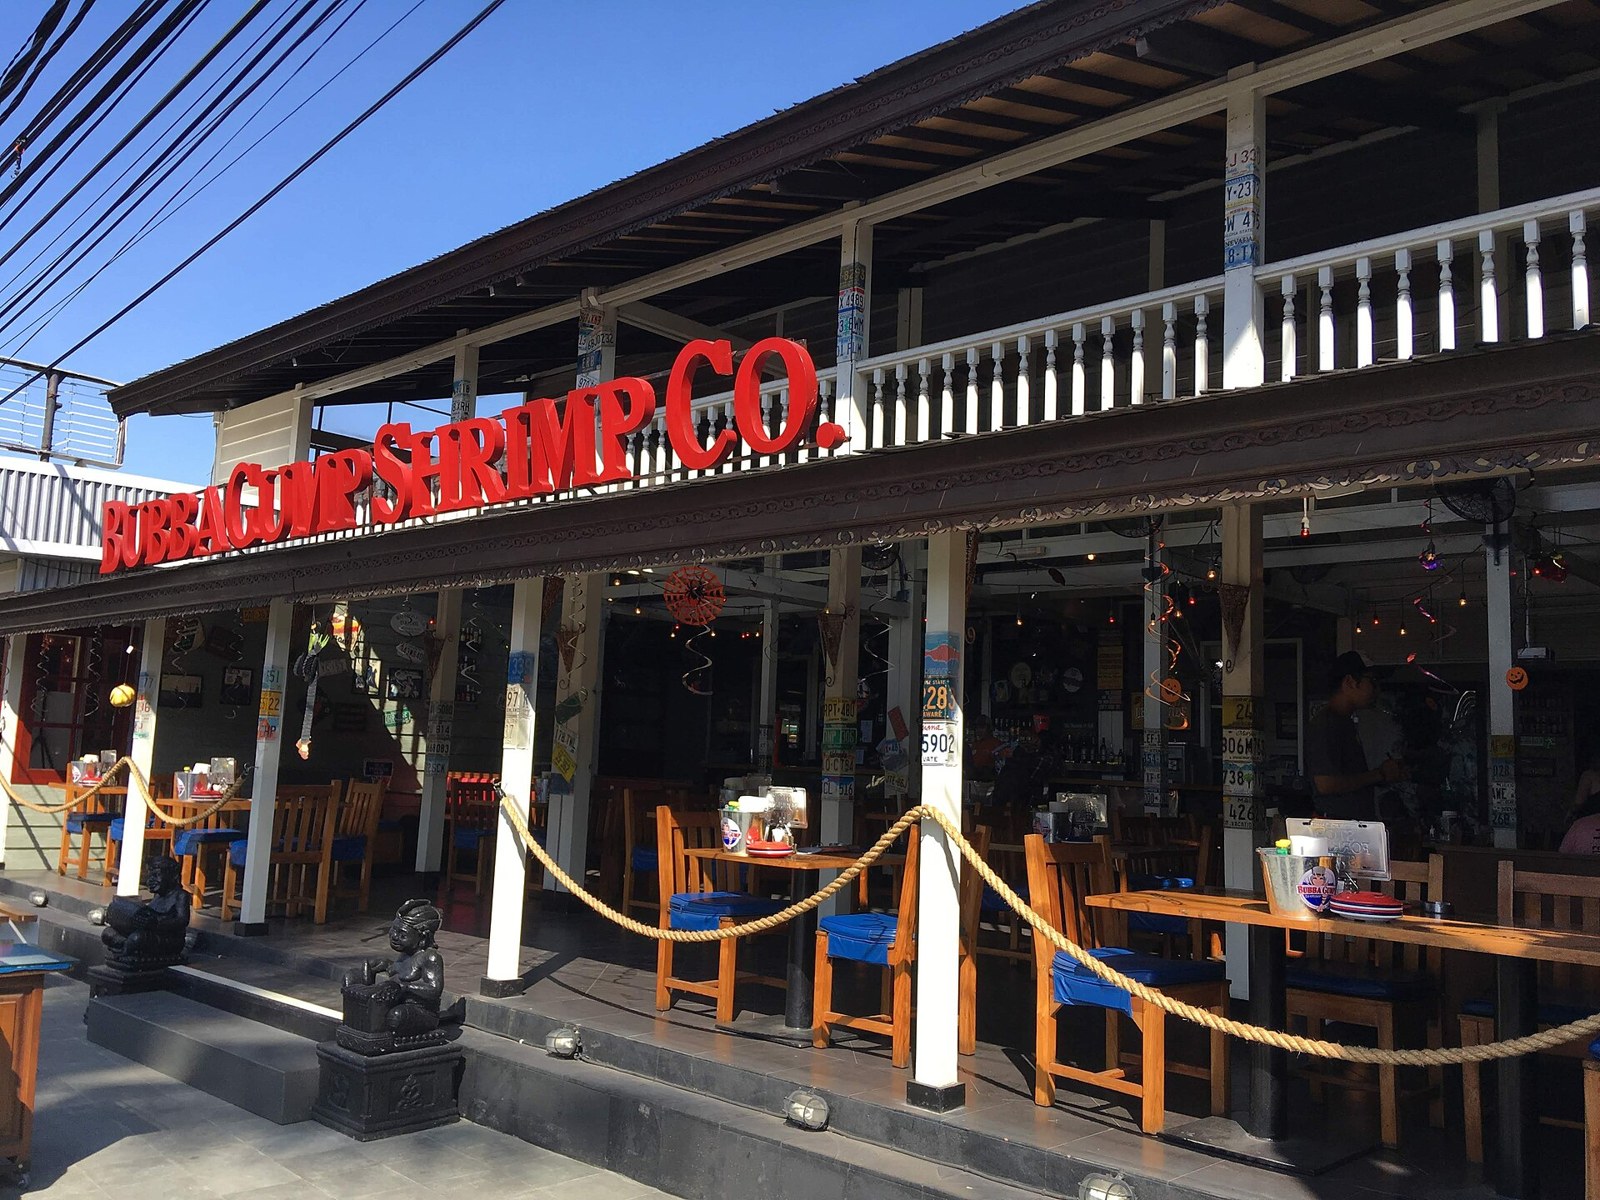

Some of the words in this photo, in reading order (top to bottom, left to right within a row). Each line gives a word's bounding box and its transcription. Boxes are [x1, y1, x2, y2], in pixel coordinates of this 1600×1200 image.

[99, 485, 232, 575] BUBBA
[225, 448, 374, 550] GUMP
[371, 376, 656, 526] SHRIMP
[666, 336, 849, 470] CO.
